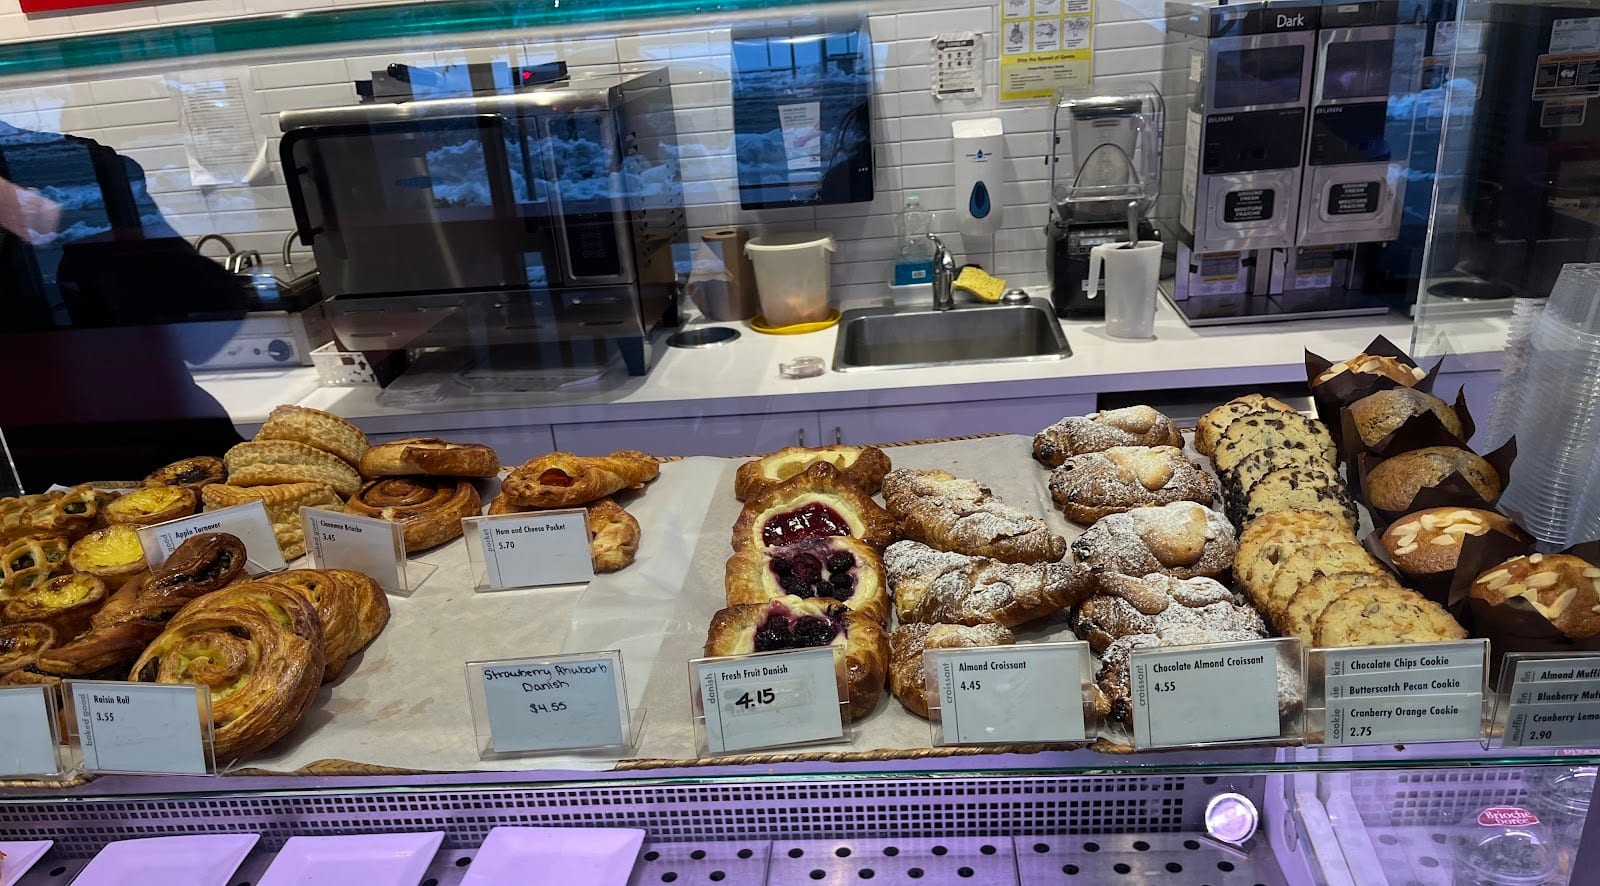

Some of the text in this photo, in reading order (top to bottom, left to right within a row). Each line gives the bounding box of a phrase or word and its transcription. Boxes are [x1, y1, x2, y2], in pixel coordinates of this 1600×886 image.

[1276, 13, 1305, 28] Dark
[175, 522, 221, 539] Apple Turnover
[495, 523, 566, 536] Ham and Cheese Pocket
[322, 533, 336, 542] 3.45
[483, 528, 495, 552] pocket
[498, 541, 515, 551] 5.70
[958, 660, 1027, 672] Almond Croissant
[1153, 655, 1264, 674] Chocolate Almond Croissant
[1350, 656, 1450, 671] Chocolate Chips Cookie
[484, 667, 552, 682] Strawberry
[721, 664, 788, 681] Fresh Fruit Danish
[1540, 669, 1574, 680] Almond
[521, 680, 570, 693] Danish
[704, 672, 716, 705] danish
[942, 662, 953, 704] croissant
[960, 680, 982, 691] 4.45
[1135, 664, 1146, 707] croissant
[1154, 681, 1176, 693] 4.55
[1349, 682, 1401, 695] Butterscotch
[1403, 681, 1428, 692] Pecan
[1430, 679, 1460, 690] Cookie
[93, 695, 131, 705] Raisin Roll
[735, 687, 776, 710] 4.15
[1537, 691, 1579, 702] Blueberry
[529, 702, 568, 714] $4.55
[1350, 705, 1459, 719] Cranberry Orange Cookie
[79, 694, 93, 746] baked good
[97, 712, 114, 722] 3.55
[1533, 713, 1576, 723] Cranberry
[1331, 708, 1341, 740] cookie
[1512, 714, 1524, 742] muffin
[1349, 726, 1373, 737] 2.75
[1529, 730, 1552, 740] 2.90
[1485, 810, 1534, 820] Brioche
